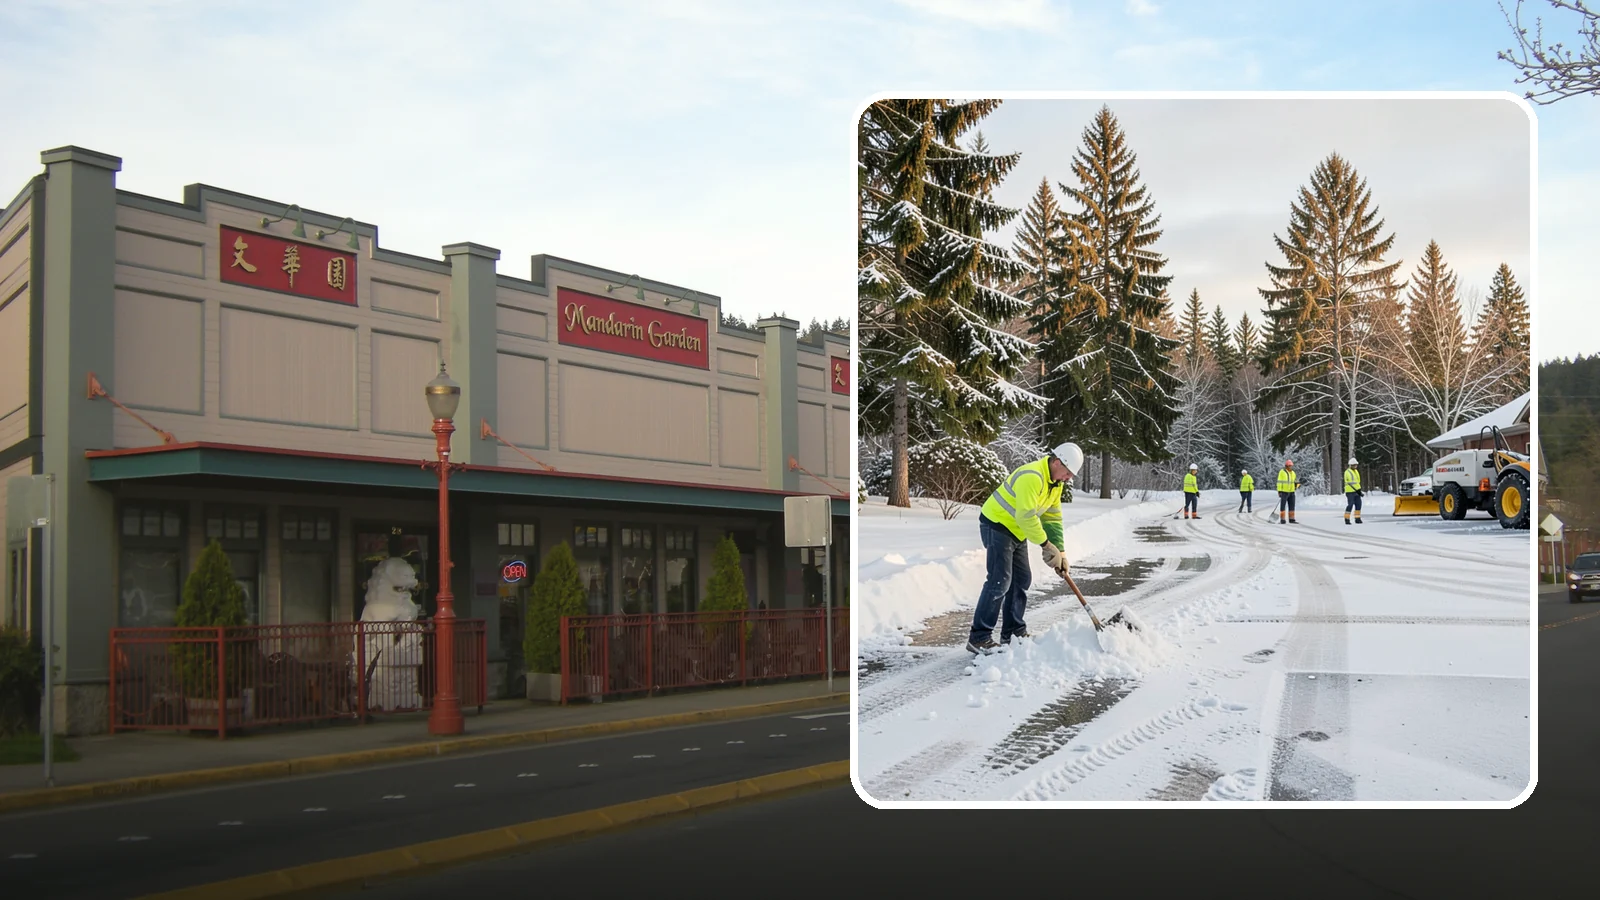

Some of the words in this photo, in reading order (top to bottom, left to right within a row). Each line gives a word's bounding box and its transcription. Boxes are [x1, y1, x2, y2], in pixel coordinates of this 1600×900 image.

[231, 236, 345, 290] 文華園
[565, 302, 643, 341] Mandarin
[648, 320, 701, 352] Garden
[503, 565, 527, 578] OPEN
